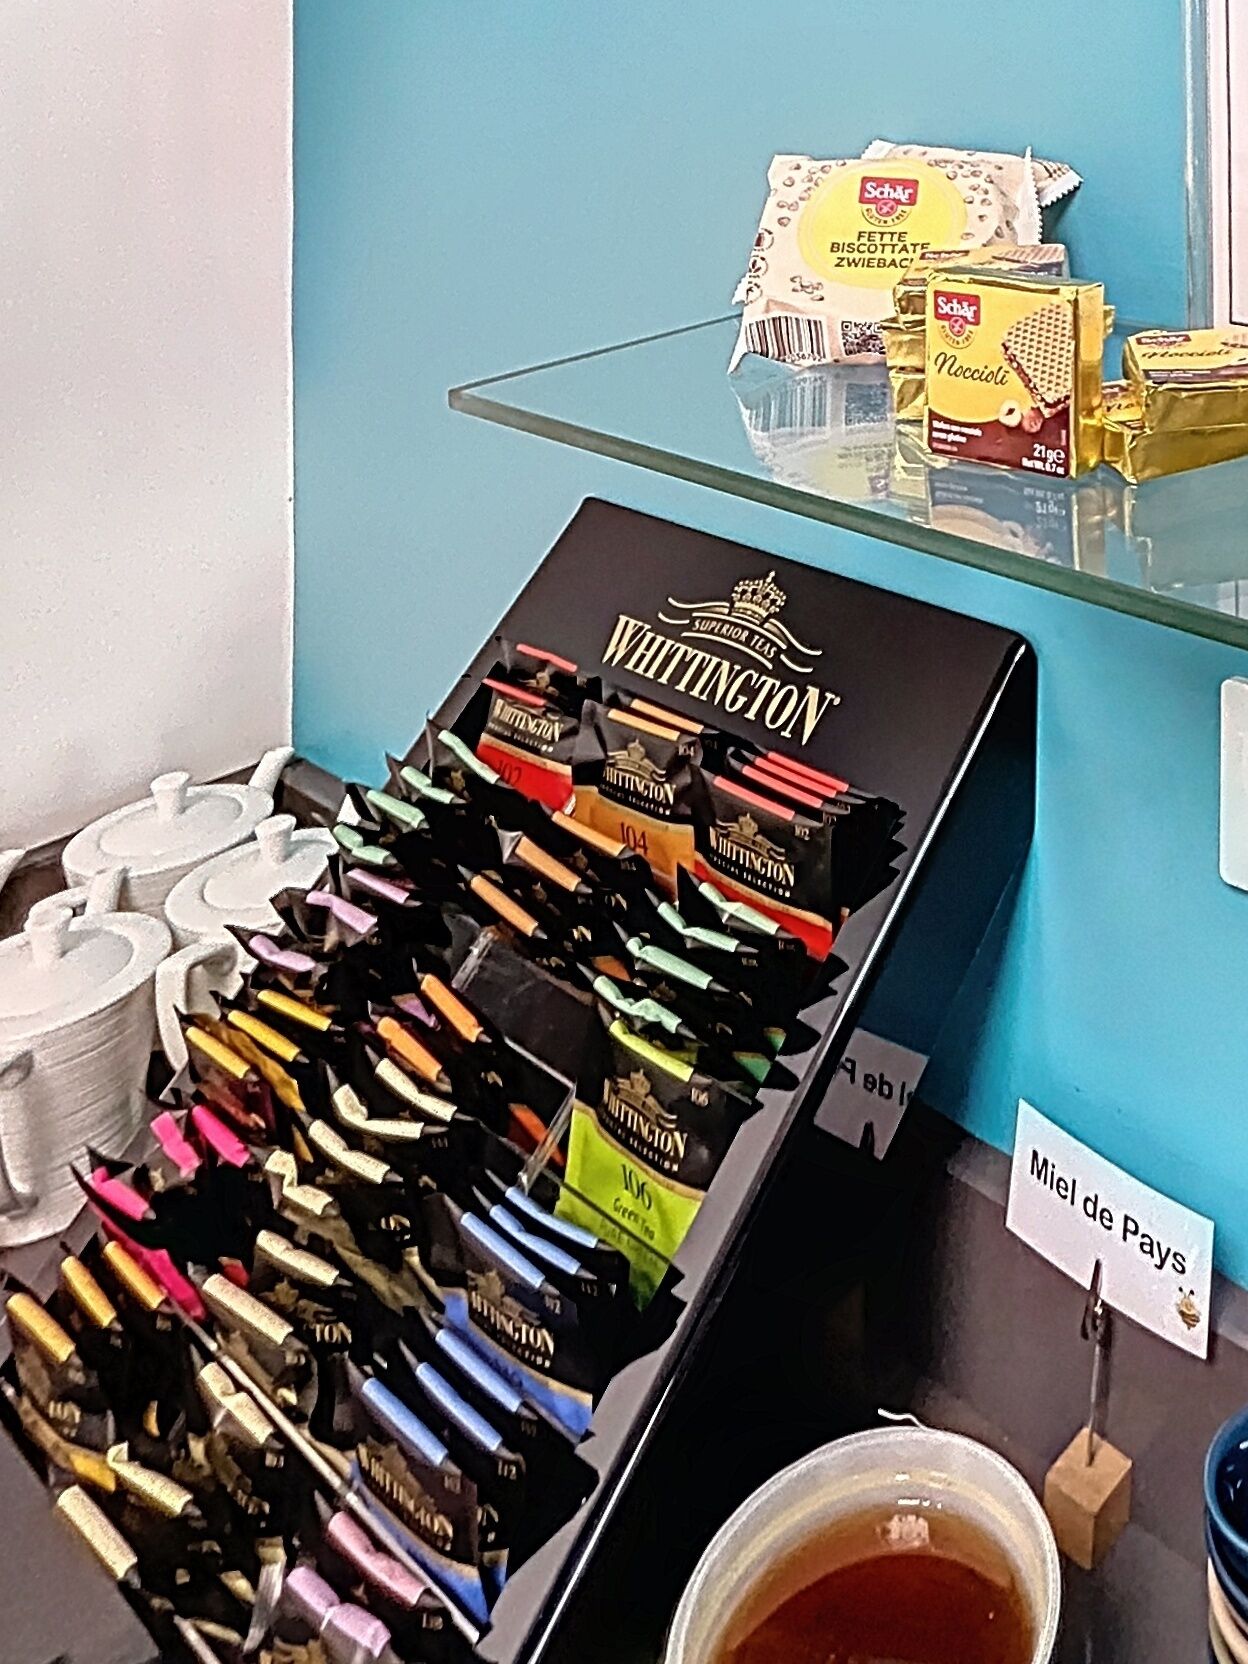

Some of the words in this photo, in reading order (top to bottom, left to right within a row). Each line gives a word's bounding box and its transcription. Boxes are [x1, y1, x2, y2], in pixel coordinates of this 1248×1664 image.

[857, 231, 908, 243] FETTE
[834, 257, 914, 269] ZWIEBAC
[934, 352, 1010, 386] Noccioli
[691, 617, 750, 643] SUPERIOR
[750, 635, 778, 660] TEAS
[601, 613, 838, 747] WHITTINGTON
[492, 698, 565, 742] WHITTINGTON
[602, 764, 677, 806] HITTINGTON
[620, 821, 649, 855] 104
[709, 825, 795, 887] WHITTINGTON
[603, 1077, 689, 1159] WHITTINGTON
[621, 1163, 652, 1211] 106
[1030, 1149, 1077, 1206] Miel
[1082, 1193, 1114, 1231] de
[1122, 1213, 1187, 1275] Pays
[471, 1290, 555, 1357] ITTINGTON
